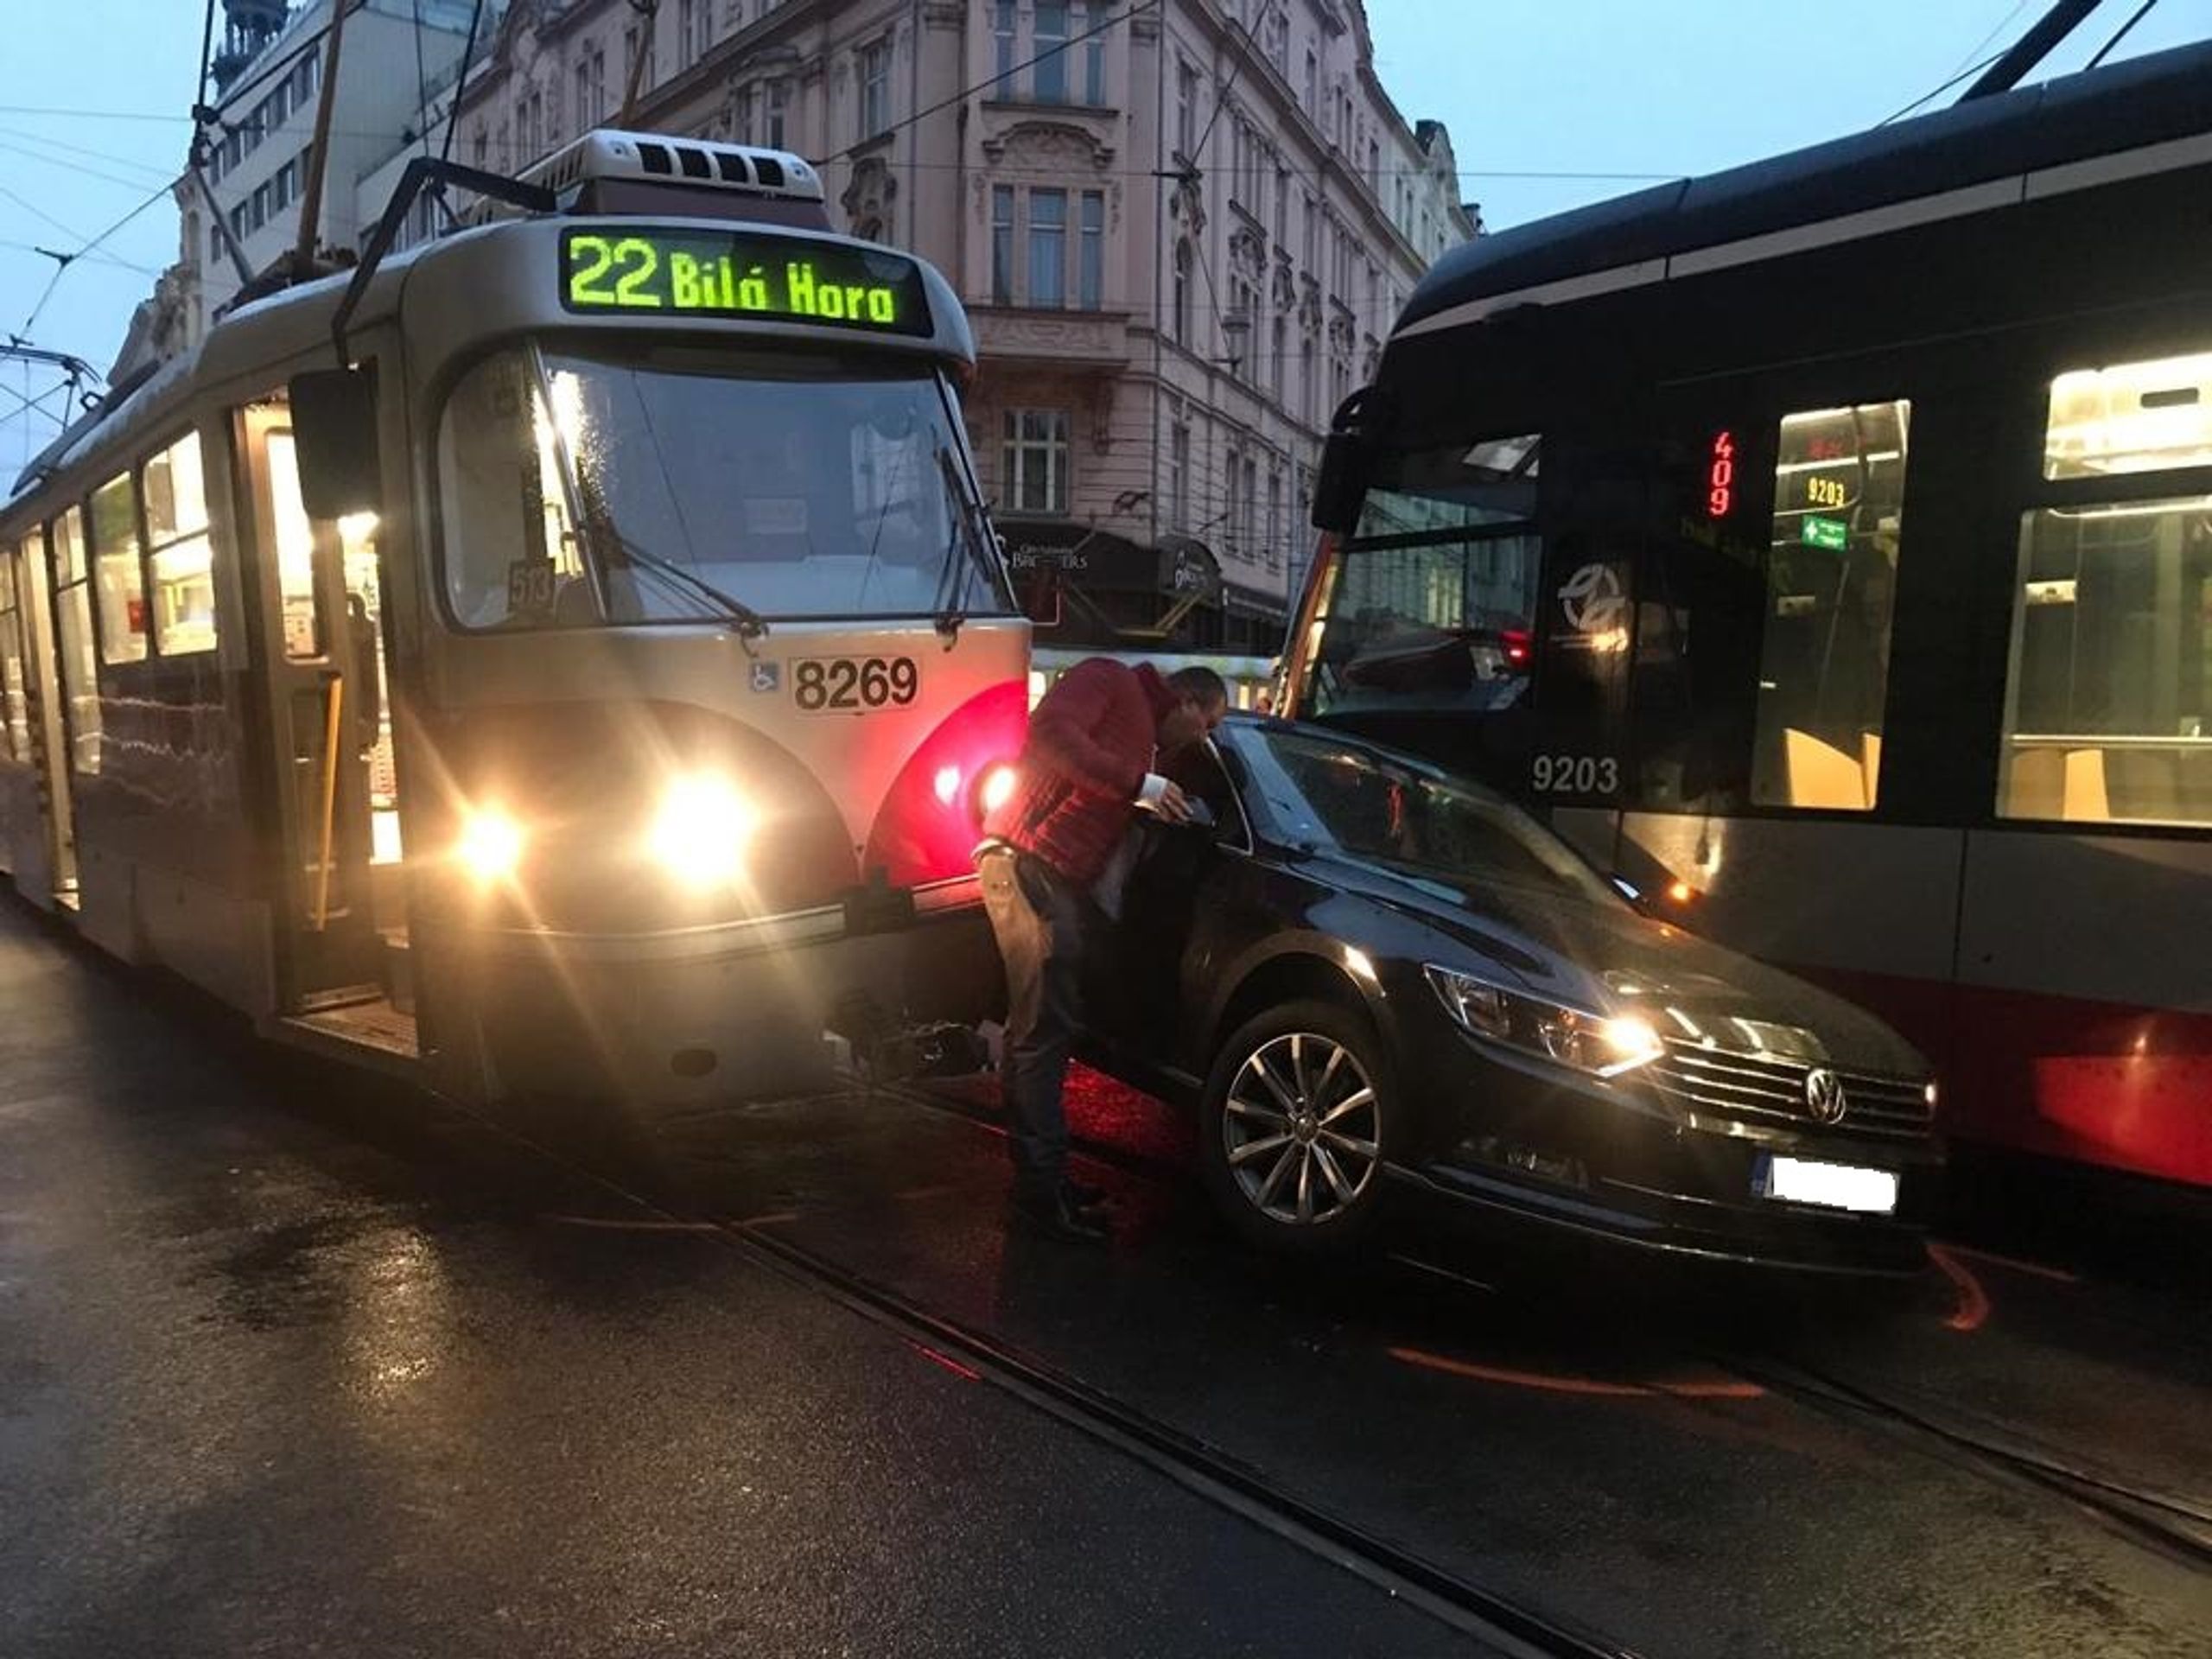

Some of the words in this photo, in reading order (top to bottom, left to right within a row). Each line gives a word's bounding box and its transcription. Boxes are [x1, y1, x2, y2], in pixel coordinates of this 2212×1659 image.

[569, 236, 661, 308] 22
[786, 263, 894, 323] Hora
[1710, 431, 1732, 517] 409
[1808, 477, 1845, 507] 9203
[794, 656, 918, 710] 8269
[1532, 754, 1618, 794] 9203
